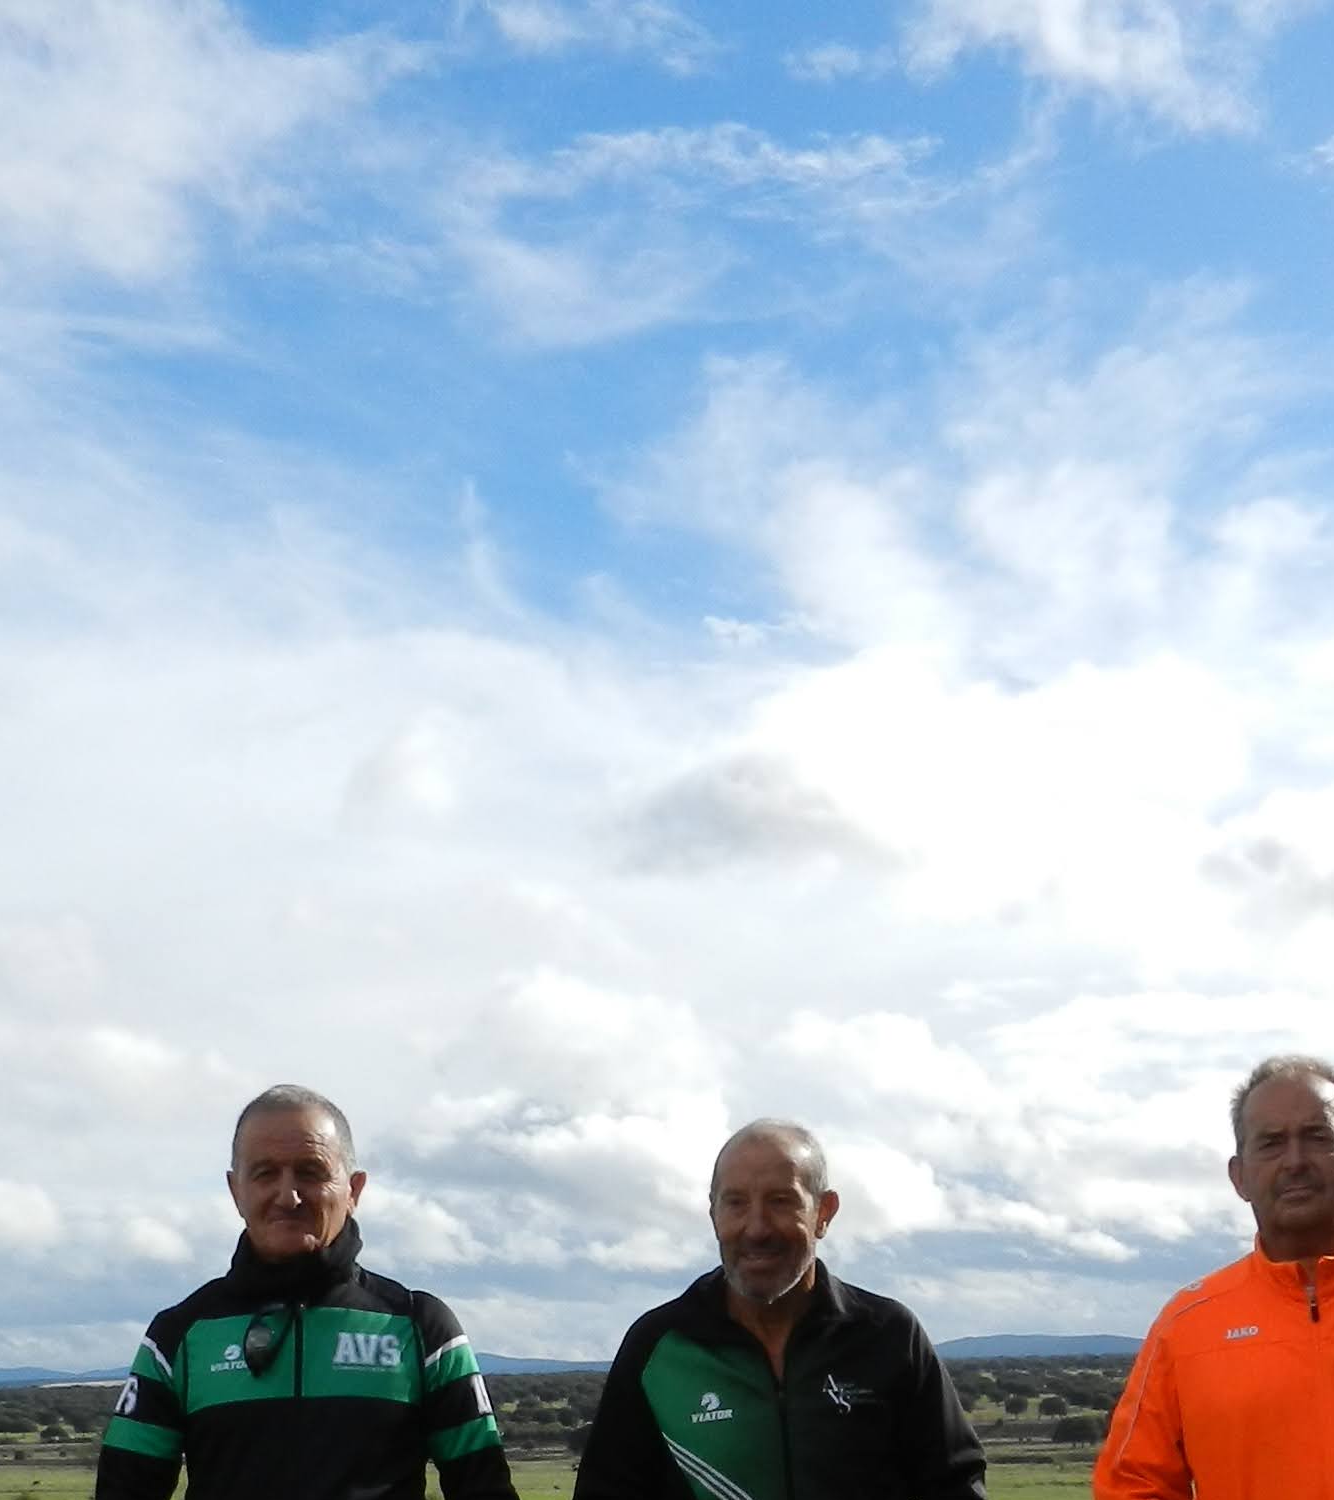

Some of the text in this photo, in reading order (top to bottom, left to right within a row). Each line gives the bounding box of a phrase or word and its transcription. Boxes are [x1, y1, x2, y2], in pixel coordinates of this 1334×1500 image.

[1226, 1325, 1259, 1340] JAKO
[332, 1331, 402, 1367] AVS
[210, 1358, 249, 1372] VIATO
[690, 1408, 734, 1424] VIATOR
